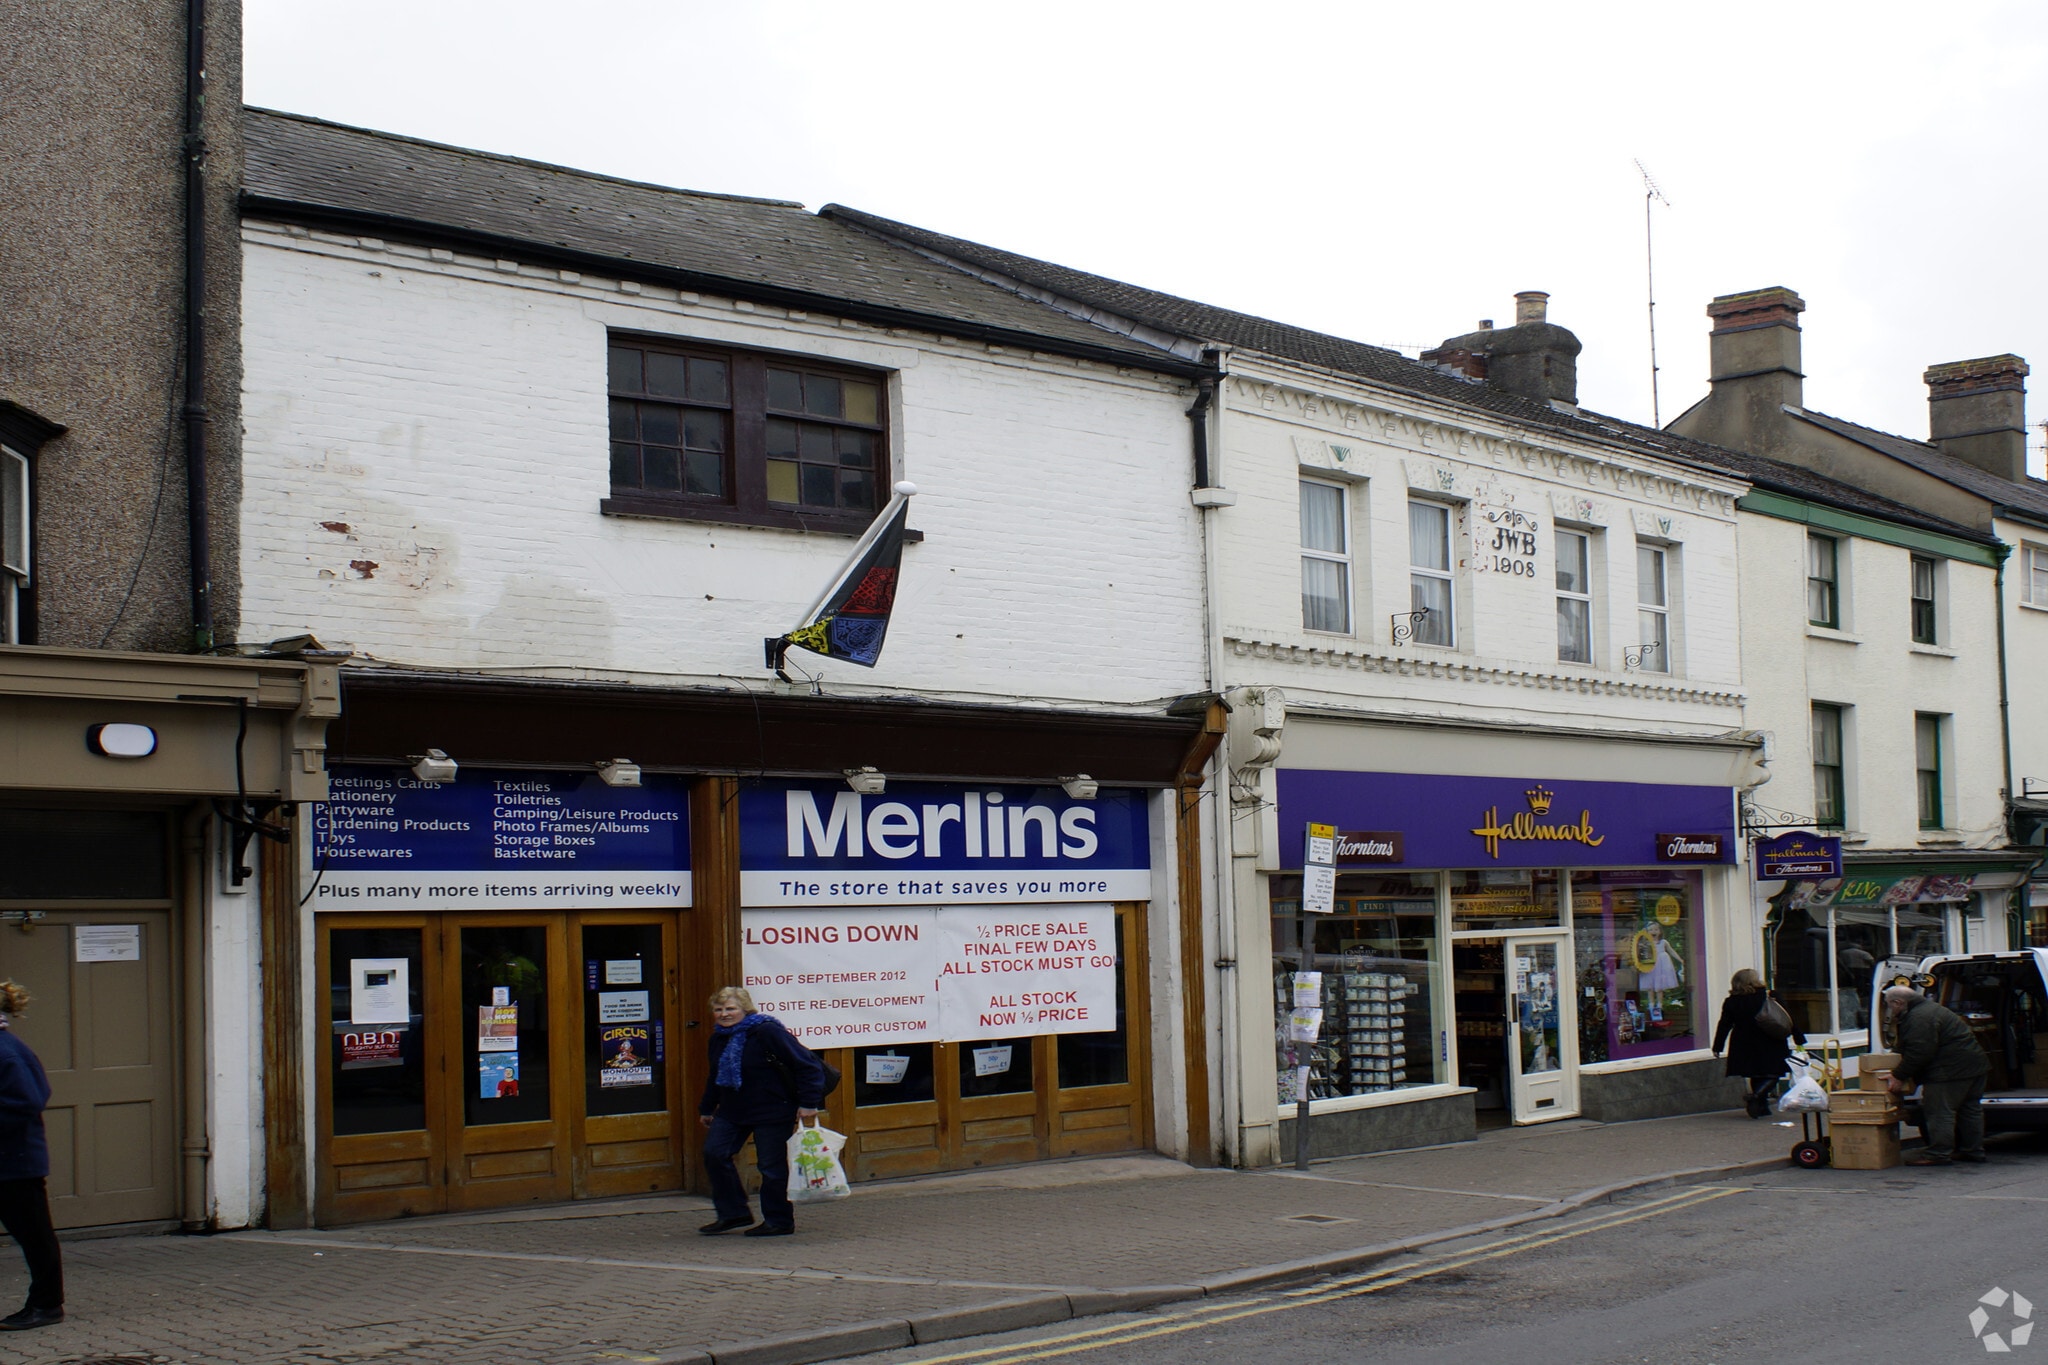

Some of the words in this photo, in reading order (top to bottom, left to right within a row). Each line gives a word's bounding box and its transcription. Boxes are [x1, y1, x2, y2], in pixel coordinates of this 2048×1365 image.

[1492, 527, 1536, 556] JWB
[1493, 555, 1535, 577] 1908
[328, 777, 392, 790] reetings
[494, 780, 550, 792] Textiles
[328, 790, 396, 804] ationery
[494, 794, 561, 805] Toiletries
[316, 804, 394, 816] Partyware
[494, 807, 616, 821] Camping/Leisure
[620, 810, 678, 821] Products
[316, 818, 398, 832] Gardening
[404, 820, 470, 831] Products
[494, 821, 535, 832] Photo
[540, 822, 649, 834] Frames/Albums
[786, 790, 1098, 859] Merlins
[317, 832, 355, 845] Toys
[1470, 806, 1605, 859] Hallmark
[494, 834, 549, 847] Storage
[555, 836, 595, 846] Boxes
[1668, 836, 1717, 857] Thorntons
[317, 846, 412, 858] Housewares
[494, 848, 576, 859] Basketware
[1765, 847, 1832, 862] Hallmark
[1776, 864, 1822, 874] Thorntons
[318, 884, 360, 898] Plus
[367, 886, 421, 900] many
[428, 885, 478, 897] more
[485, 883, 537, 896] items
[544, 882, 614, 898] arriving
[620, 882, 681, 897] weekly
[780, 881, 820, 896] The
[830, 882, 888, 896] store
[898, 880, 943, 895] that
[952, 881, 1008, 894] saves
[1017, 880, 1051, 895] you
[1059, 880, 1107, 893] more
[1840, 880, 1881, 901] KING
[741, 926, 839, 945] LOSING
[847, 924, 918, 943] DOWN
[995, 924, 1041, 937] PRICE
[1046, 923, 1088, 935] SALE
[964, 943, 1011, 956] FINAL
[1015, 941, 1048, 954] FEW
[1054, 939, 1096, 952] DAYS
[943, 962, 976, 975] ALL
[981, 959, 1034, 973] STOCK
[1039, 957, 1085, 970] MUST
[746, 975, 771, 986] END
[775, 975, 793, 985] OF
[798, 972, 876, 984] SEPTEMBER
[880, 971, 906, 981] 2012
[758, 1002, 775, 1012] TO
[779, 1001, 806, 1011] SITE
[810, 995, 925, 1009] RE-DEVELOPMENT
[990, 995, 1017, 1008] ALL
[1022, 991, 1077, 1006] STOCK
[980, 1013, 1016, 1026] NOW
[1038, 1008, 1088, 1022] PRICE
[603, 1028, 648, 1041] CIRCUS
[806, 1026, 832, 1036] FOR
[835, 1024, 870, 1034] YOUR
[875, 1021, 927, 1032] CUSTOM
